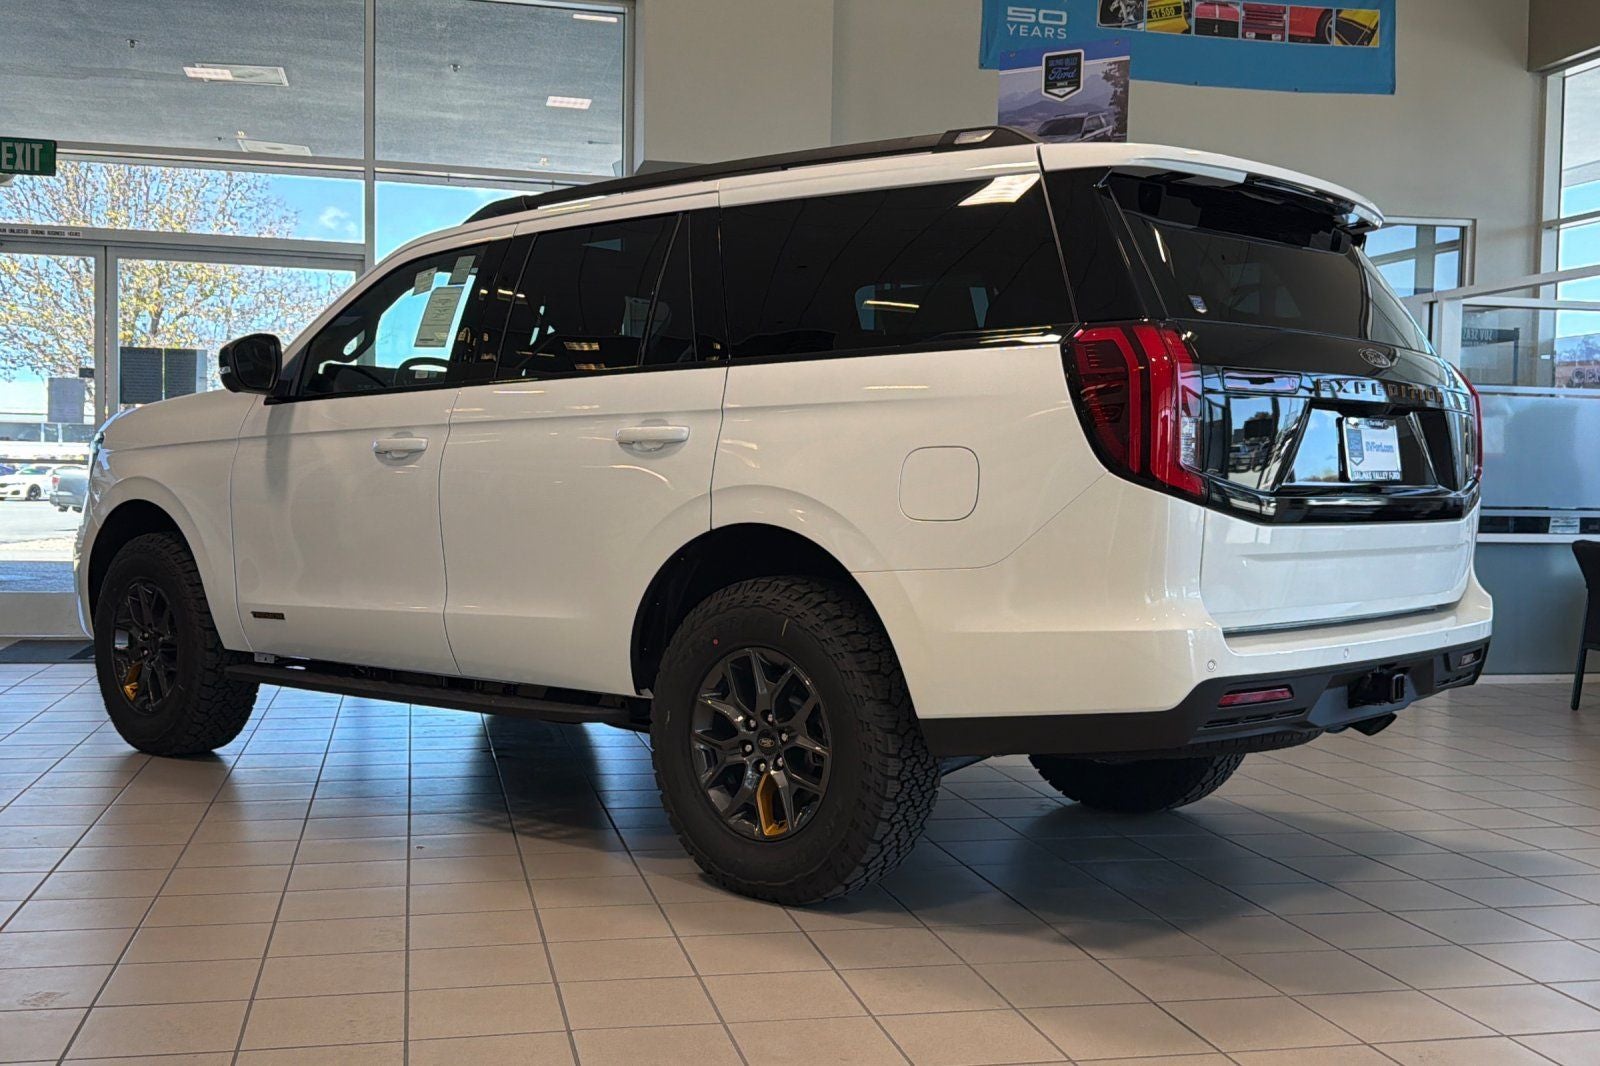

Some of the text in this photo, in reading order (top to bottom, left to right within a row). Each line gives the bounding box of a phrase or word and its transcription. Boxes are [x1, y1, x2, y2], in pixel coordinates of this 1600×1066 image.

[1007, 6, 1067, 25] 50
[1151, 7, 1175, 18] GT 500
[1007, 24, 1067, 40] YEARS
[1048, 67, 1077, 80] Ford
[1, 141, 44, 171] EXIT
[1314, 378, 1443, 404] EXPEDITION
